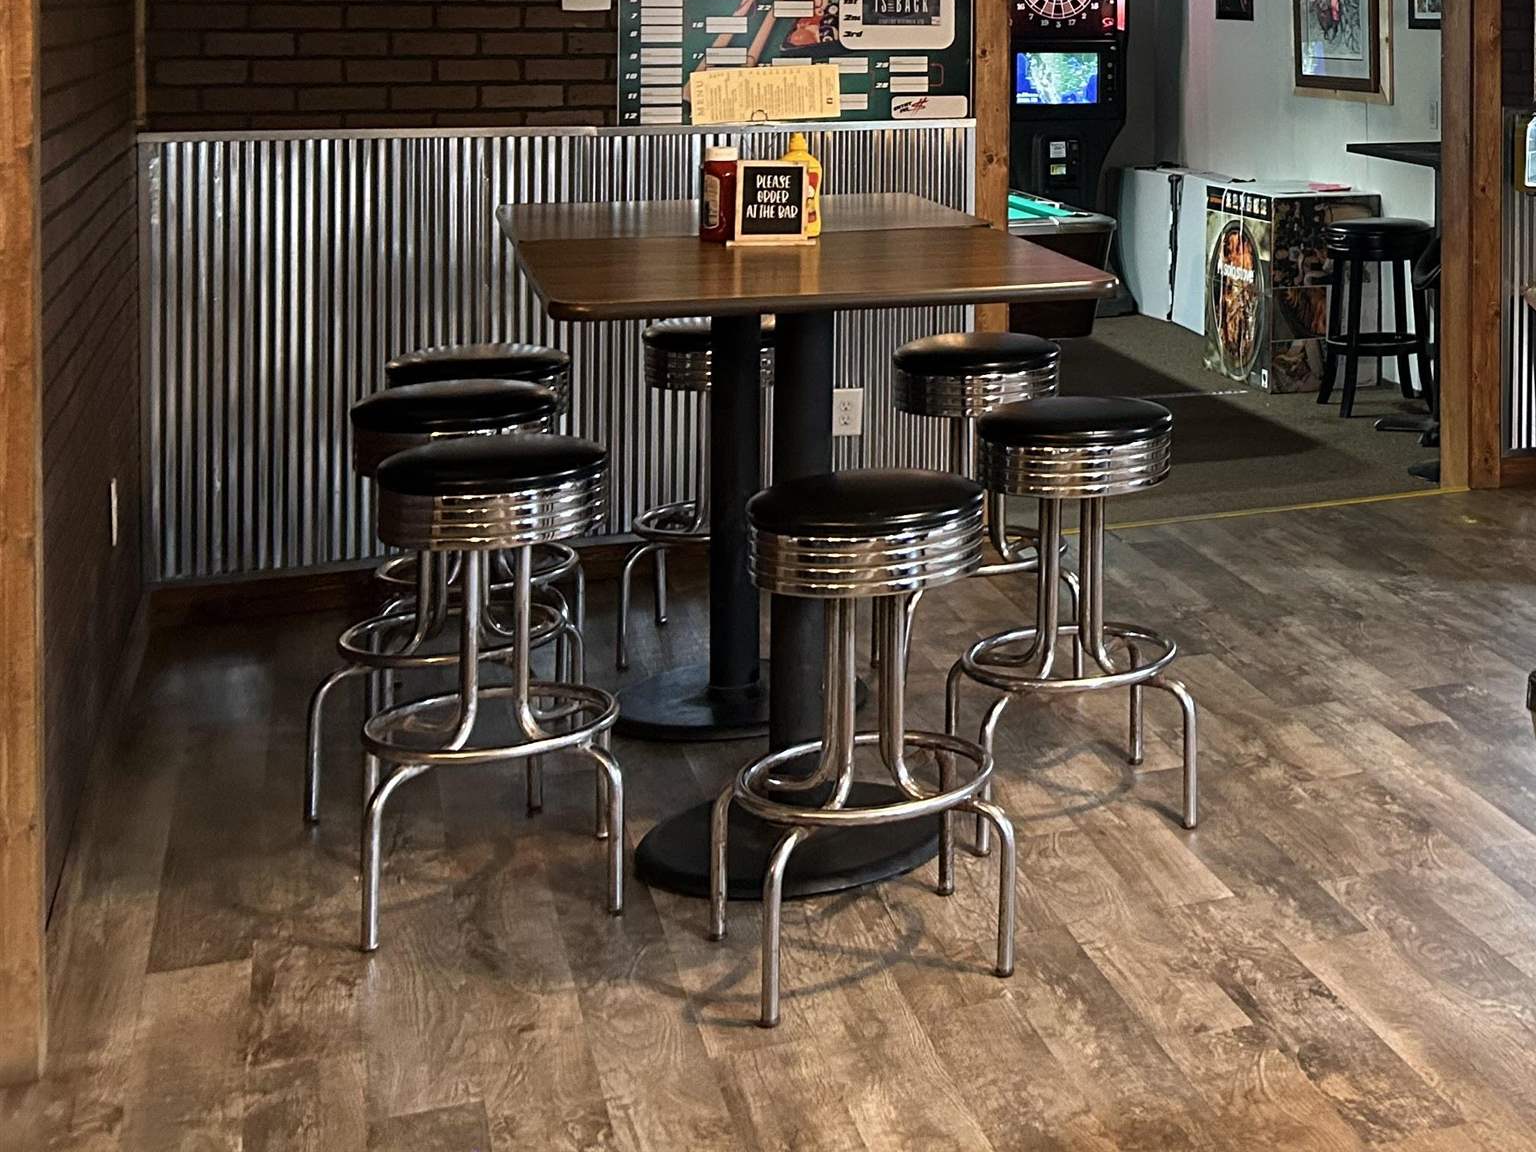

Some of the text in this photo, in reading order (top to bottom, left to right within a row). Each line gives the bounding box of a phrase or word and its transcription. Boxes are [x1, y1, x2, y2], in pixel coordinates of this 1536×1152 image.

[843, 30, 863, 38] 3rd
[756, 174, 792, 189] PLEASE
[757, 189, 789, 204] ORDER
[746, 204, 758, 219] AT
[758, 204, 775, 219] THE
[778, 204, 798, 219] BAR
